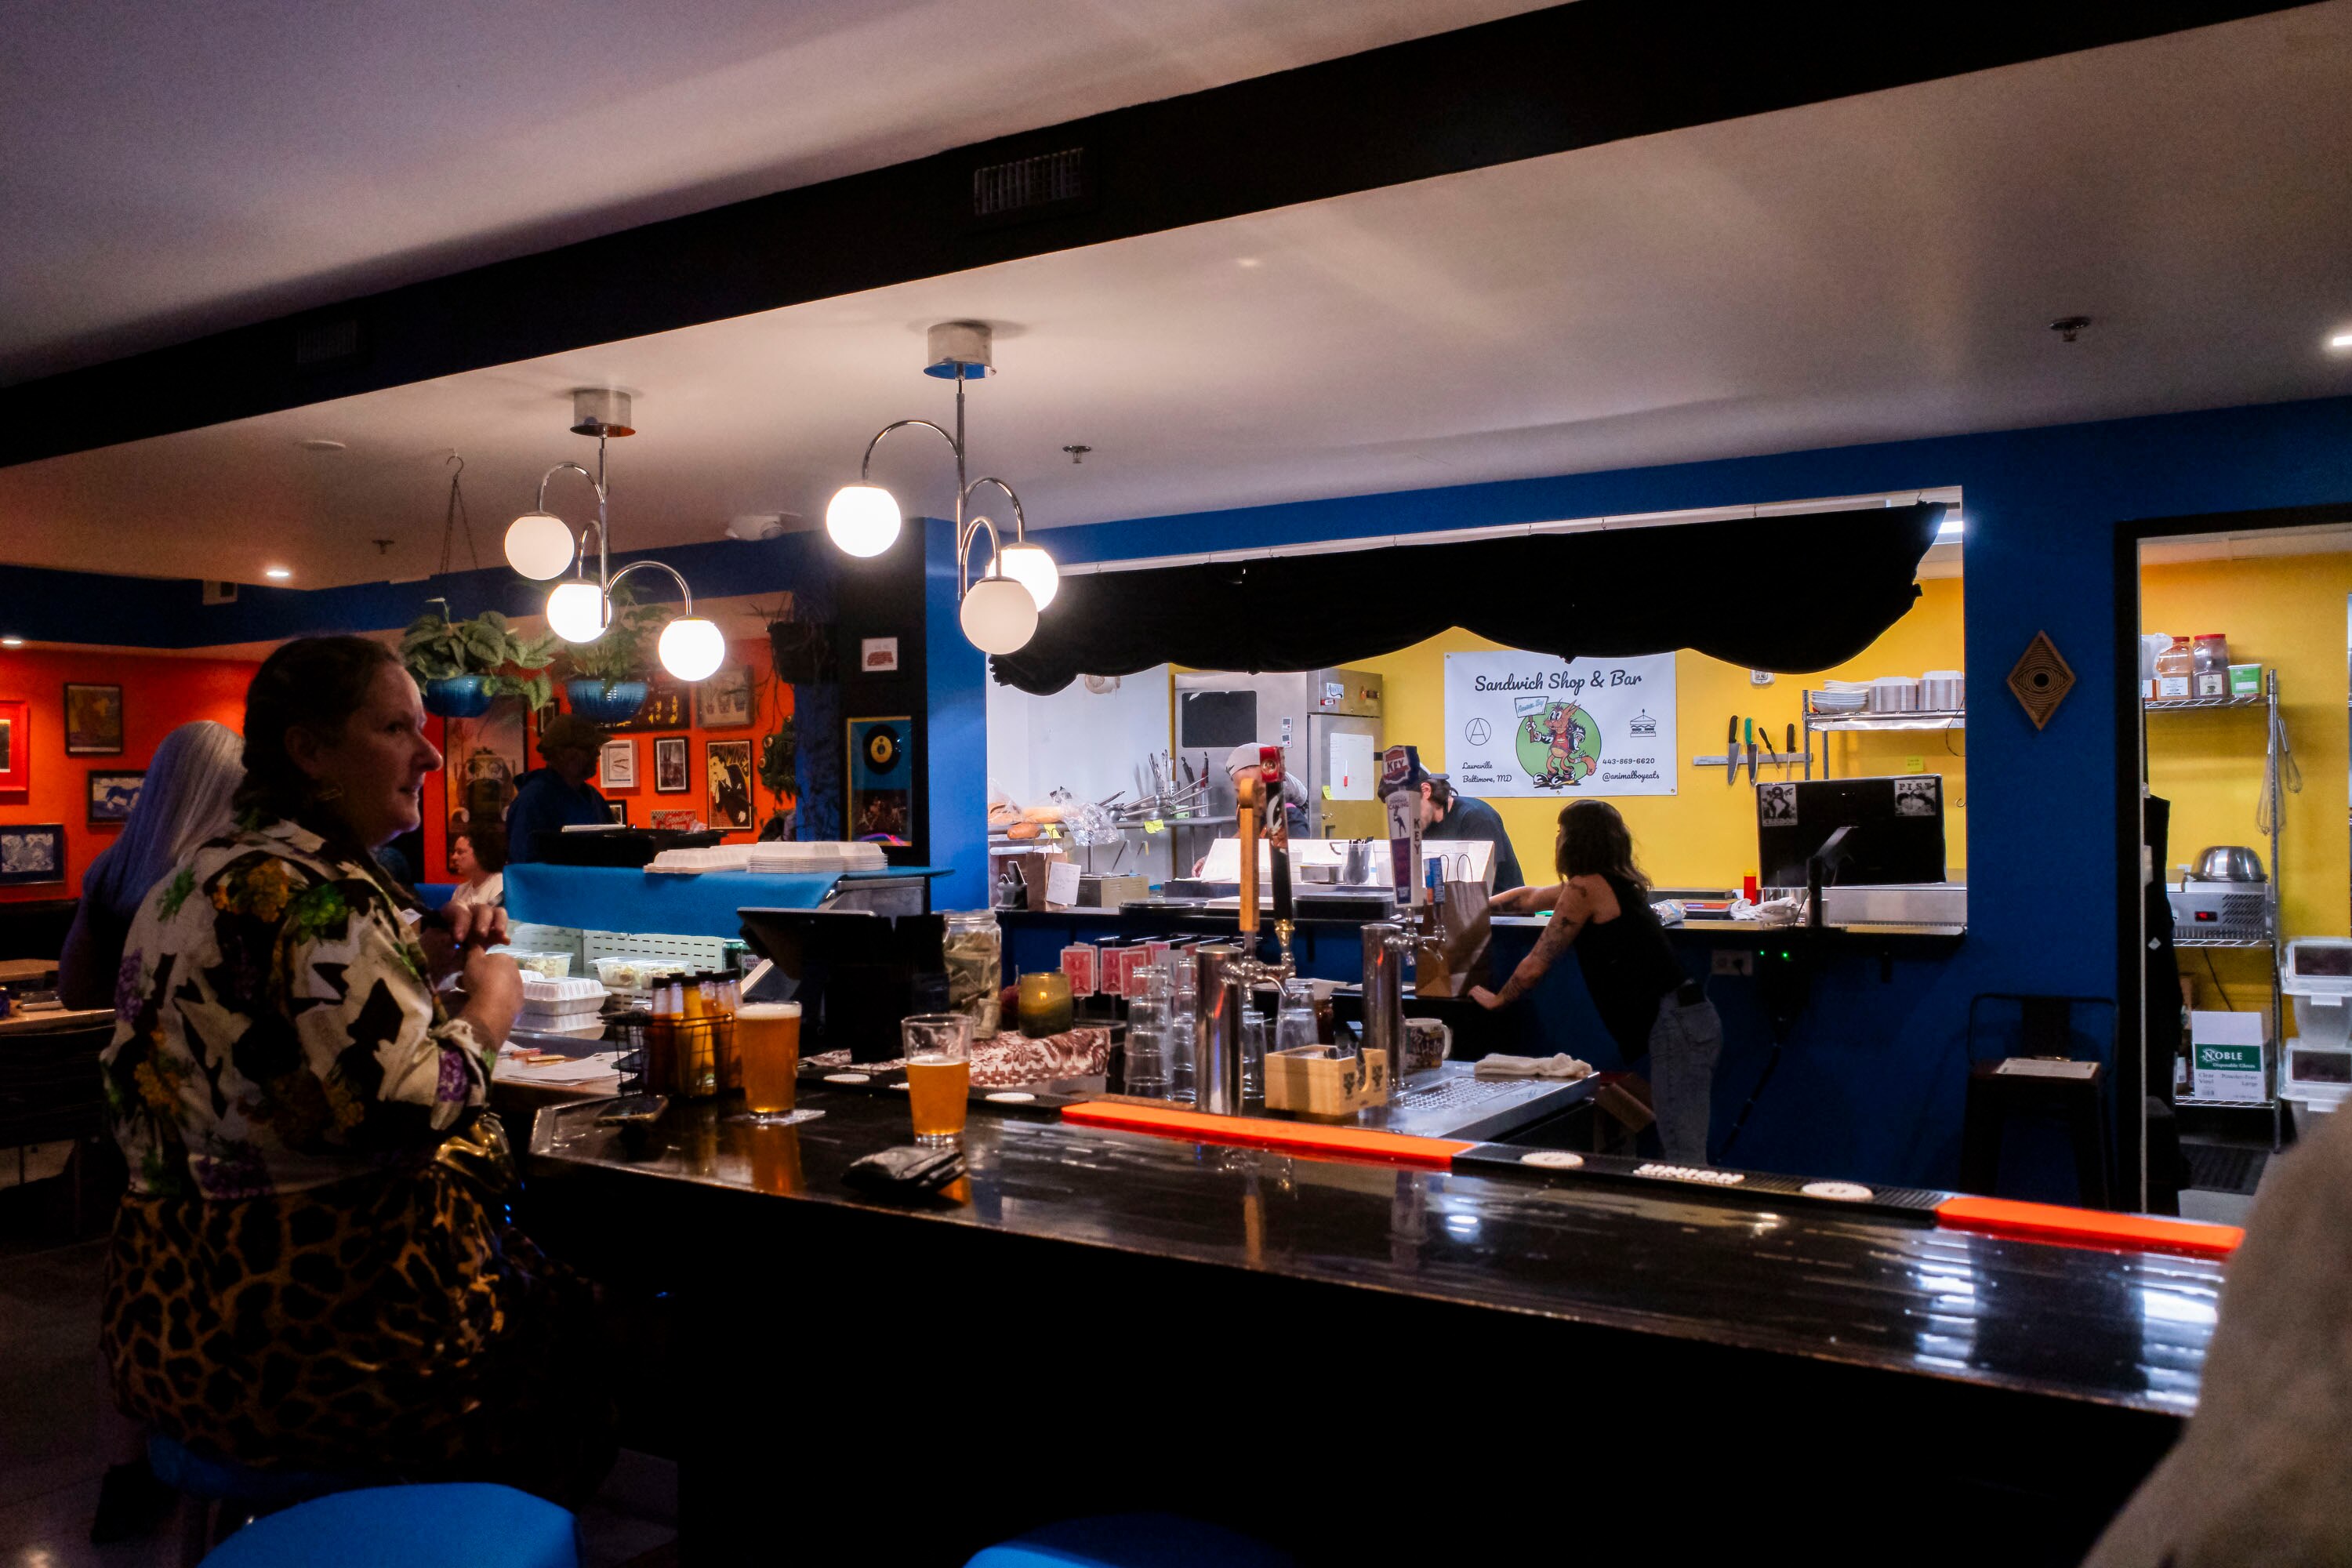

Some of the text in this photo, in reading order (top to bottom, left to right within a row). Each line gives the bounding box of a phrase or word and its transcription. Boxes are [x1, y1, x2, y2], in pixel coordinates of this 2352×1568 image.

[1475, 669, 1642, 696] Sandwich Shop & Bar
[1387, 757, 1404, 773] KEY
[1461, 760, 1493, 769] Lauraville
[1462, 774, 1512, 783] Baltimore, MD
[1602, 770, 1660, 783] @animalboyeats
[2204, 1051, 2243, 1061] NOBLE
[1633, 1163, 1745, 1185] UNION
